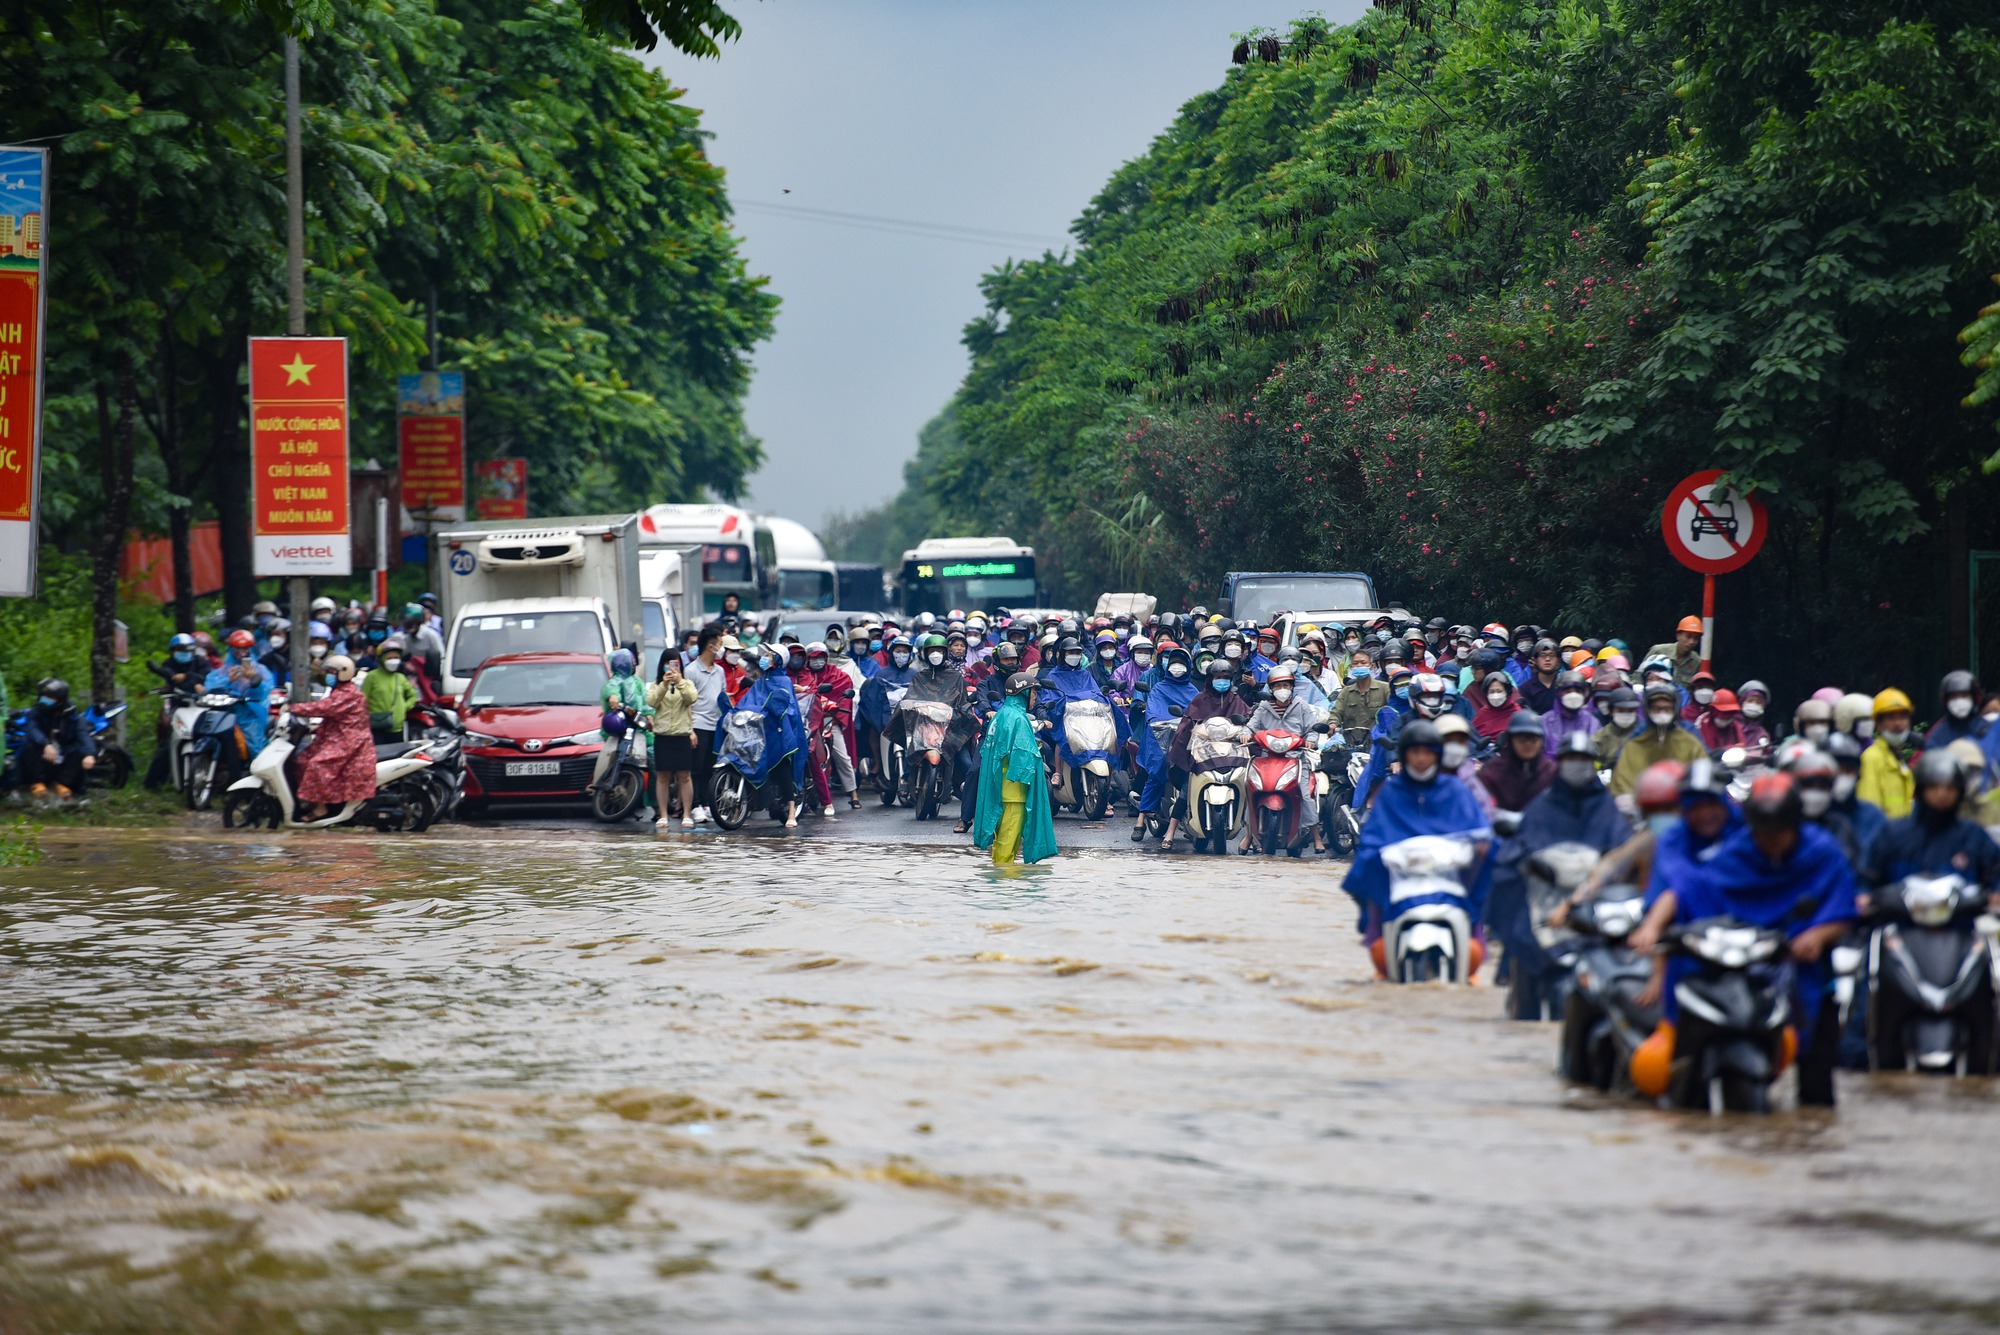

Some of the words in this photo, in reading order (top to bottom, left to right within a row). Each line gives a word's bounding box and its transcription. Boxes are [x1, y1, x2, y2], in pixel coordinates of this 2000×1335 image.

[256, 416, 287, 431] NƯỚC
[287, 416, 317, 434] CỘNG
[318, 416, 342, 430] HÒA
[280, 439, 296, 454] XÃ
[297, 439, 318, 457] HỘI
[268, 461, 292, 477] CHỦ
[294, 461, 332, 477] NGHĨA
[273, 486, 299, 503] VIỆT
[300, 487, 328, 500] NAM
[268, 508, 304, 523] MUÔN
[306, 508, 334, 523] NĂM
[271, 545, 333, 558] viettel
[453, 554, 473, 572] 20
